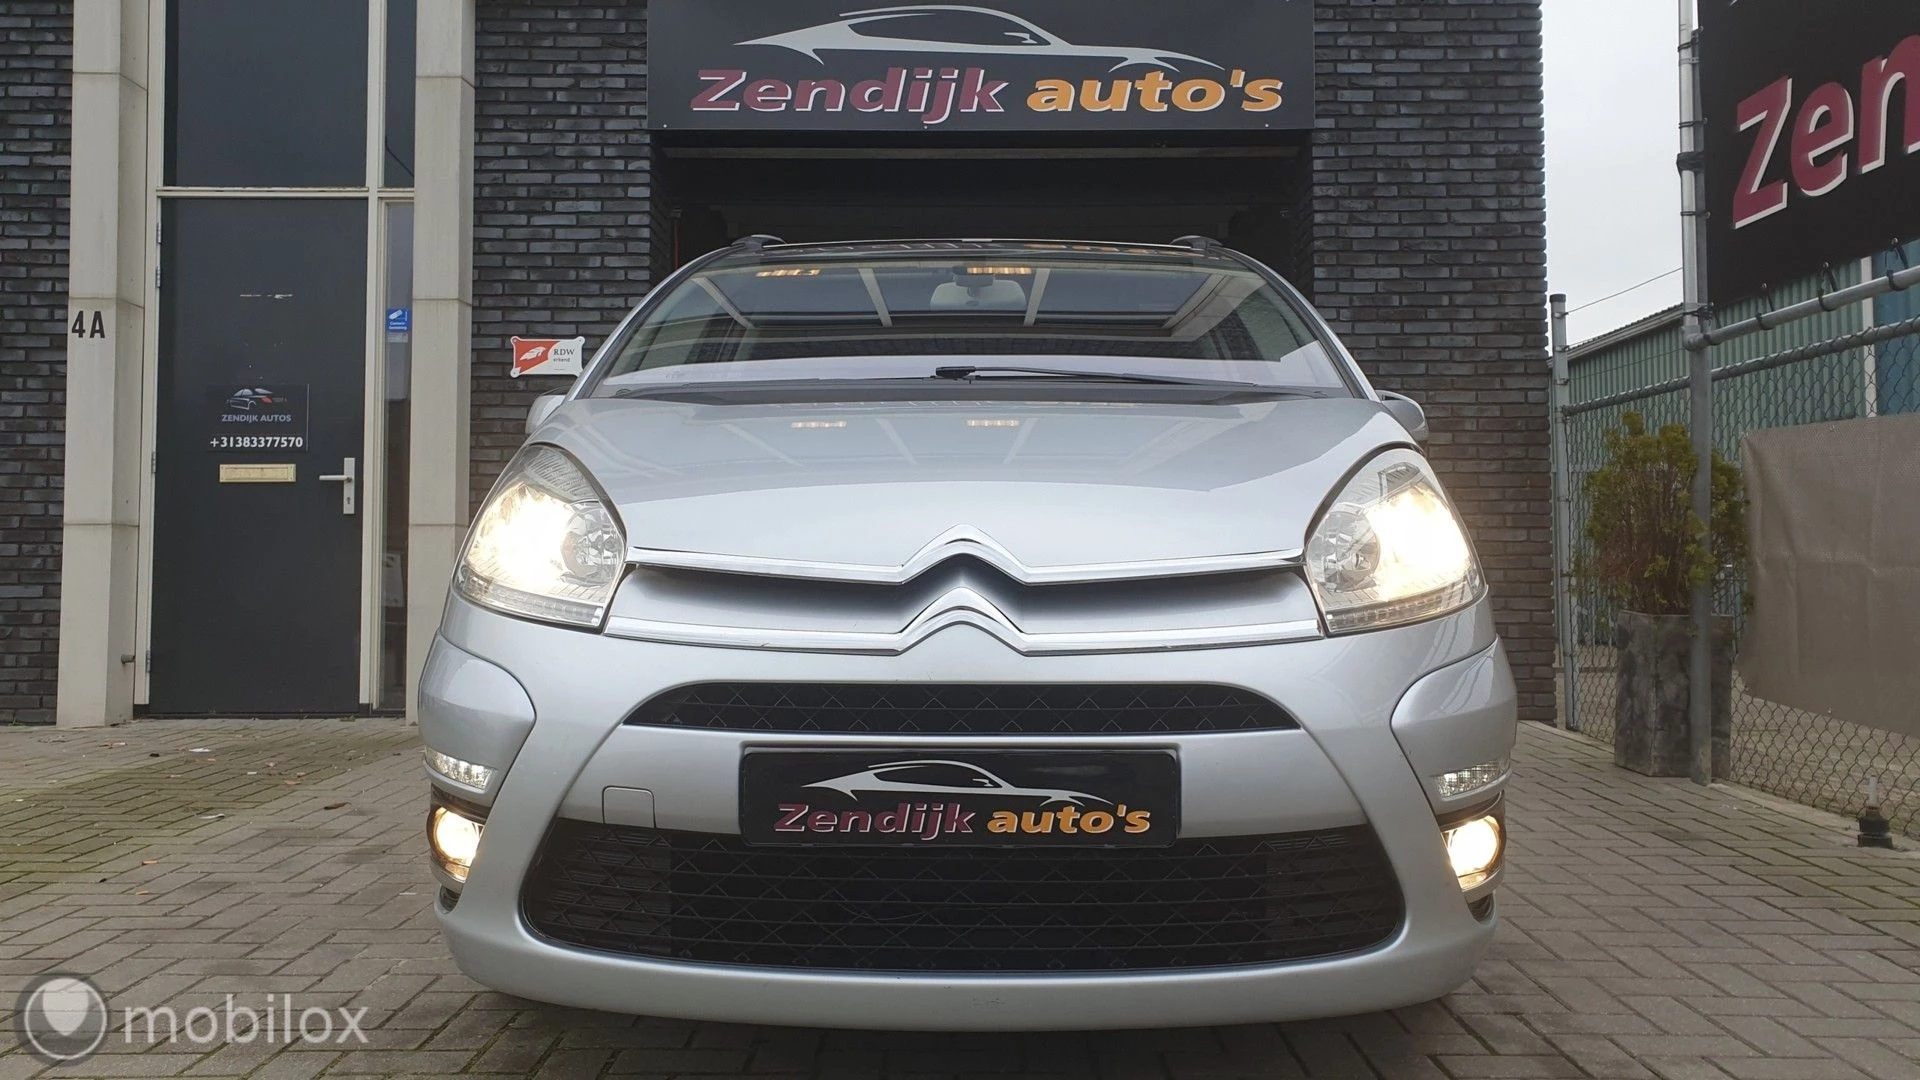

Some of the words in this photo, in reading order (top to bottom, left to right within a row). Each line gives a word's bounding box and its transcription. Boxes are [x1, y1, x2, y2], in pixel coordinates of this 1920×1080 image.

[689, 67, 1010, 125] Zendijk
[1026, 69, 1284, 113] auto's
[1732, 34, 1920, 230] Zen
[71, 310, 105, 339] 4A
[553, 348, 575, 356] RDW
[221, 414, 259, 424] ZENDIJK
[260, 414, 292, 422] AUTOS
[210, 436, 304, 448] +31383377570
[774, 802, 975, 841] Zendijk
[986, 803, 1152, 834] auto's
